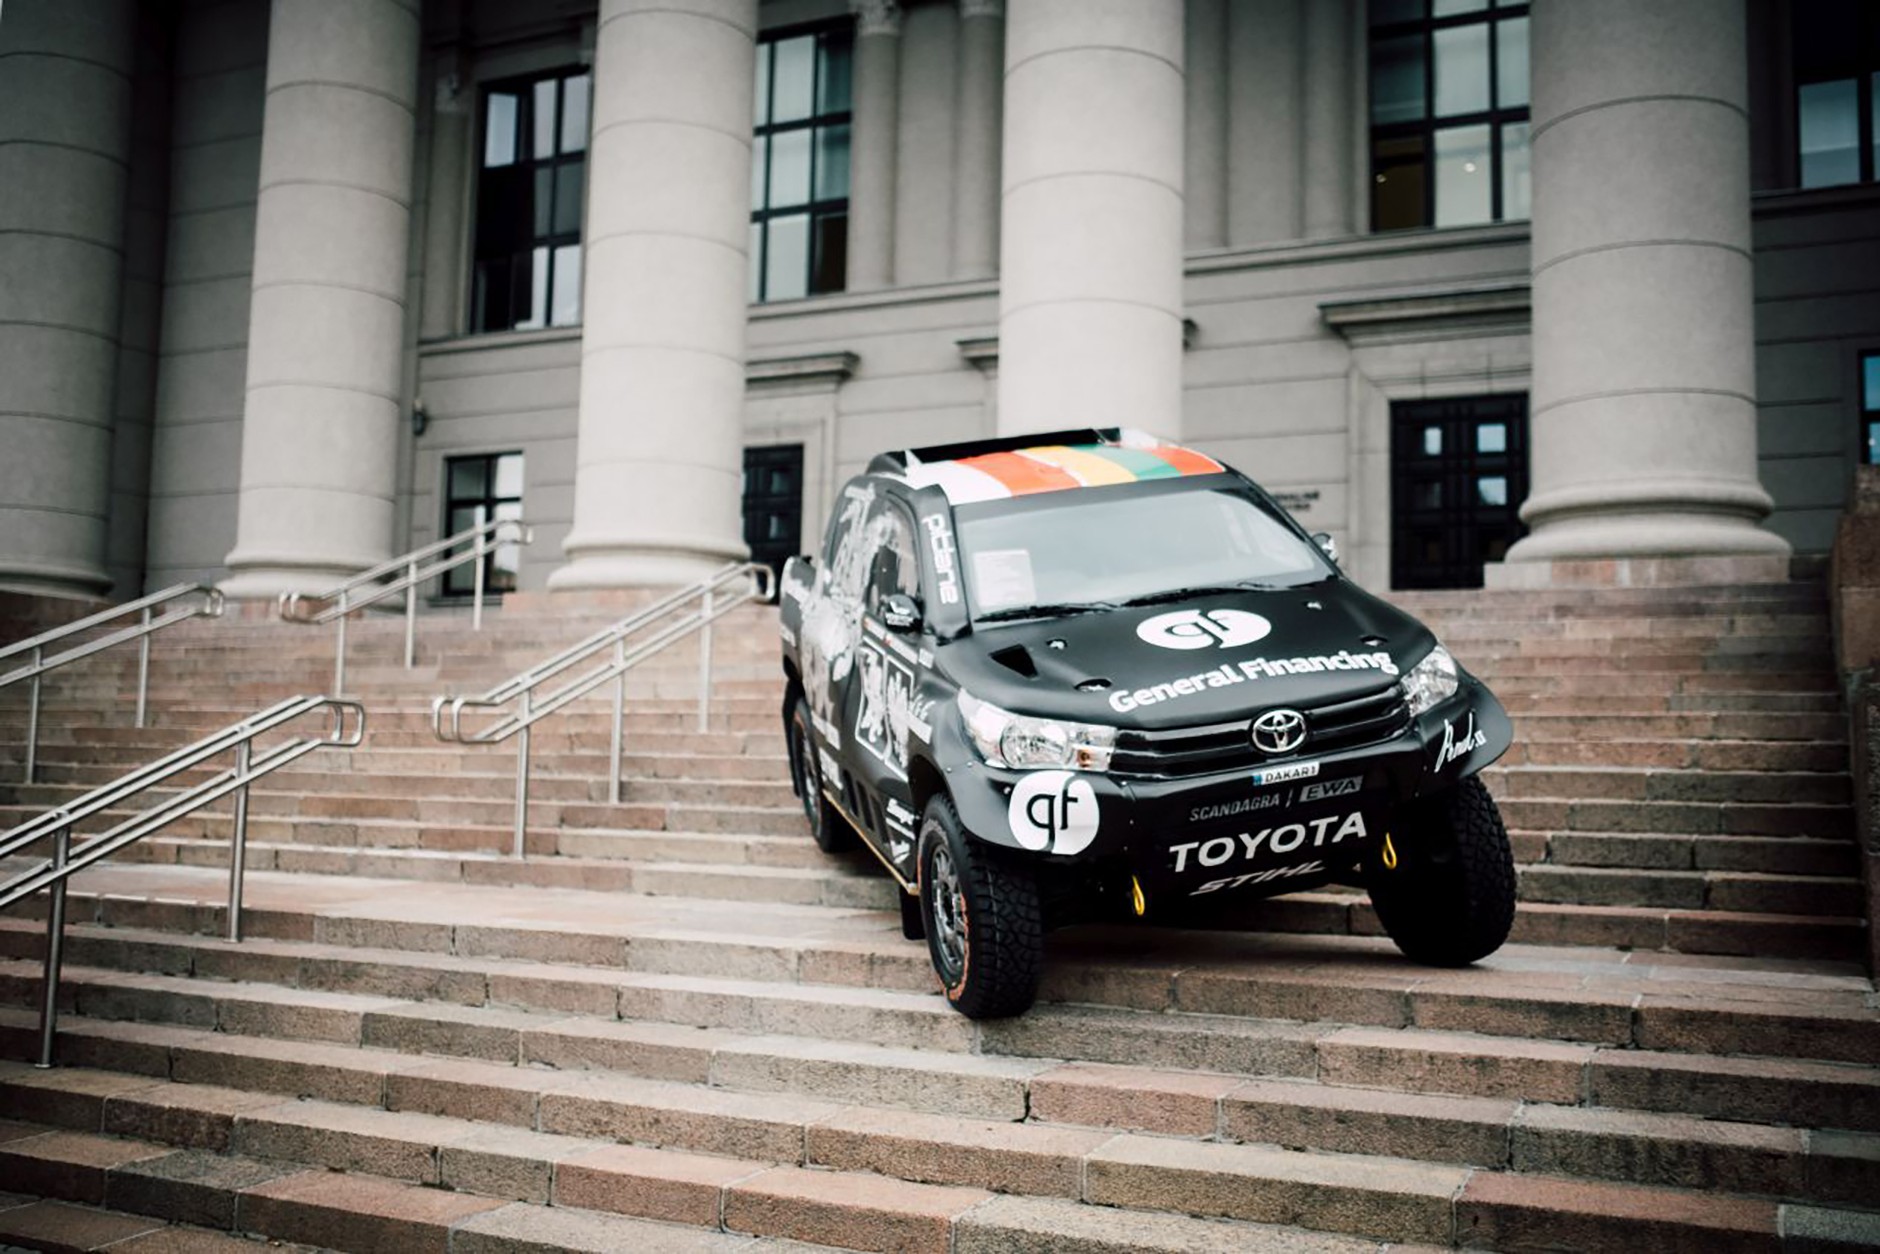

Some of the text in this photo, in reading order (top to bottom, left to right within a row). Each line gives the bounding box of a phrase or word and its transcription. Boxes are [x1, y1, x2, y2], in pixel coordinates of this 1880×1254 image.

[1109, 650, 1399, 713] General Financing
[1189, 778, 1358, 822] SCANDAGRA EWA
[1169, 811, 1367, 873] TOYOTA
[1189, 860, 1326, 896] STIHL
